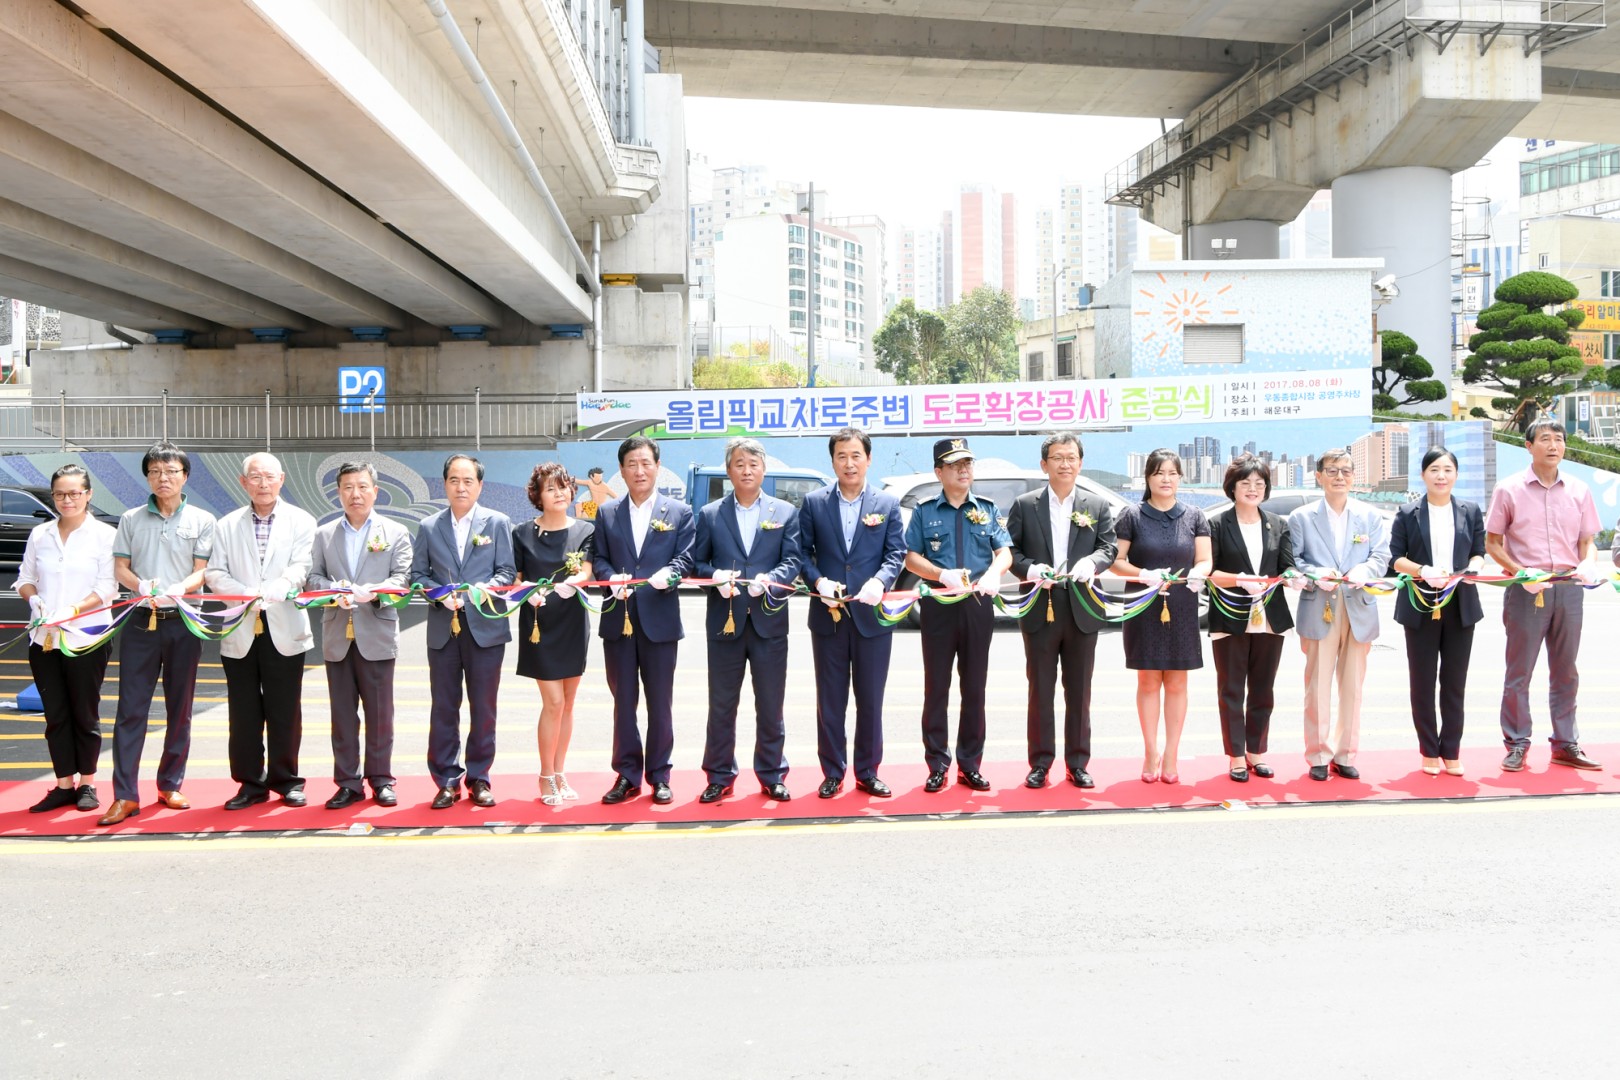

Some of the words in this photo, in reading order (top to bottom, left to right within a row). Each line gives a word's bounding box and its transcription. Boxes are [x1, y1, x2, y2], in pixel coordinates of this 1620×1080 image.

[341, 369, 383, 409] P2
[1231, 382, 1249, 391] 일시
[1264, 379, 1321, 389] 2017.08.08
[1325, 377, 1343, 387] (화)
[1231, 395, 1249, 404] 장소
[1318, 390, 1361, 399] 공영주차장
[667, 394, 909, 431] 올림픽교차로주변
[923, 388, 1108, 425] 도로확장공사
[1120, 384, 1210, 418] 준공식
[1264, 406, 1301, 415] 해운대구
